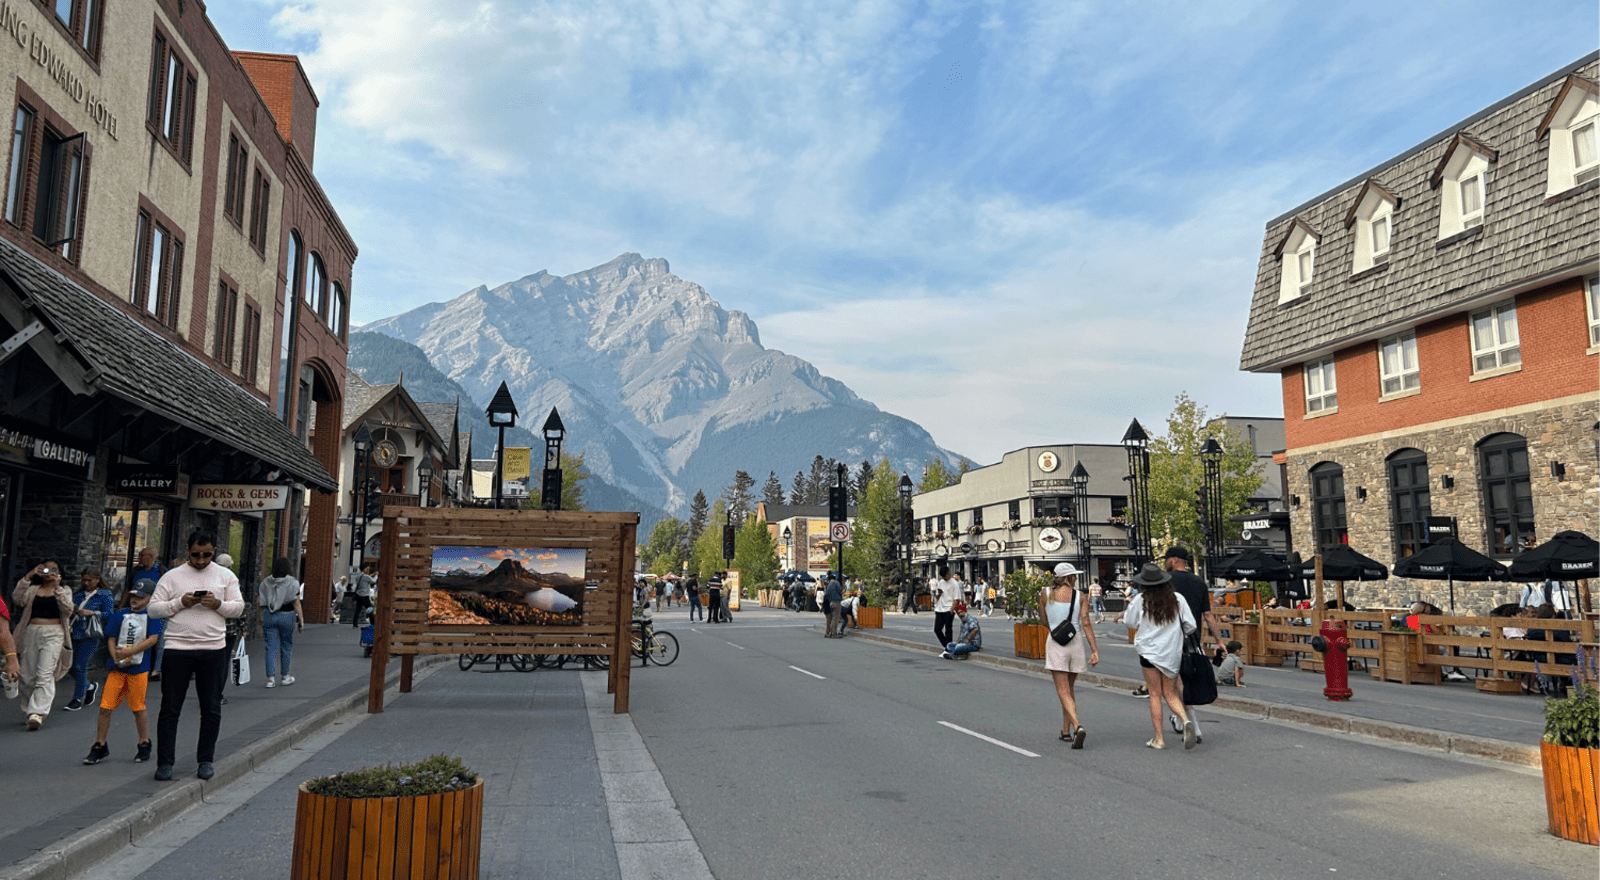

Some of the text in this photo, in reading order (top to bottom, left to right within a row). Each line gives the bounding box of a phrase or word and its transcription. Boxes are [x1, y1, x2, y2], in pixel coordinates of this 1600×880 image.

[0, 0, 118, 141] ING EDWARD HOTEL
[42, 440, 89, 467] GALLERY
[121, 479, 172, 488] GALLERY
[197, 488, 279, 499] ROCKS & GEMS
[221, 500, 253, 509] CANADA
[1243, 519, 1270, 530] BRAZEN
[1561, 562, 1594, 570] BRAZEN
